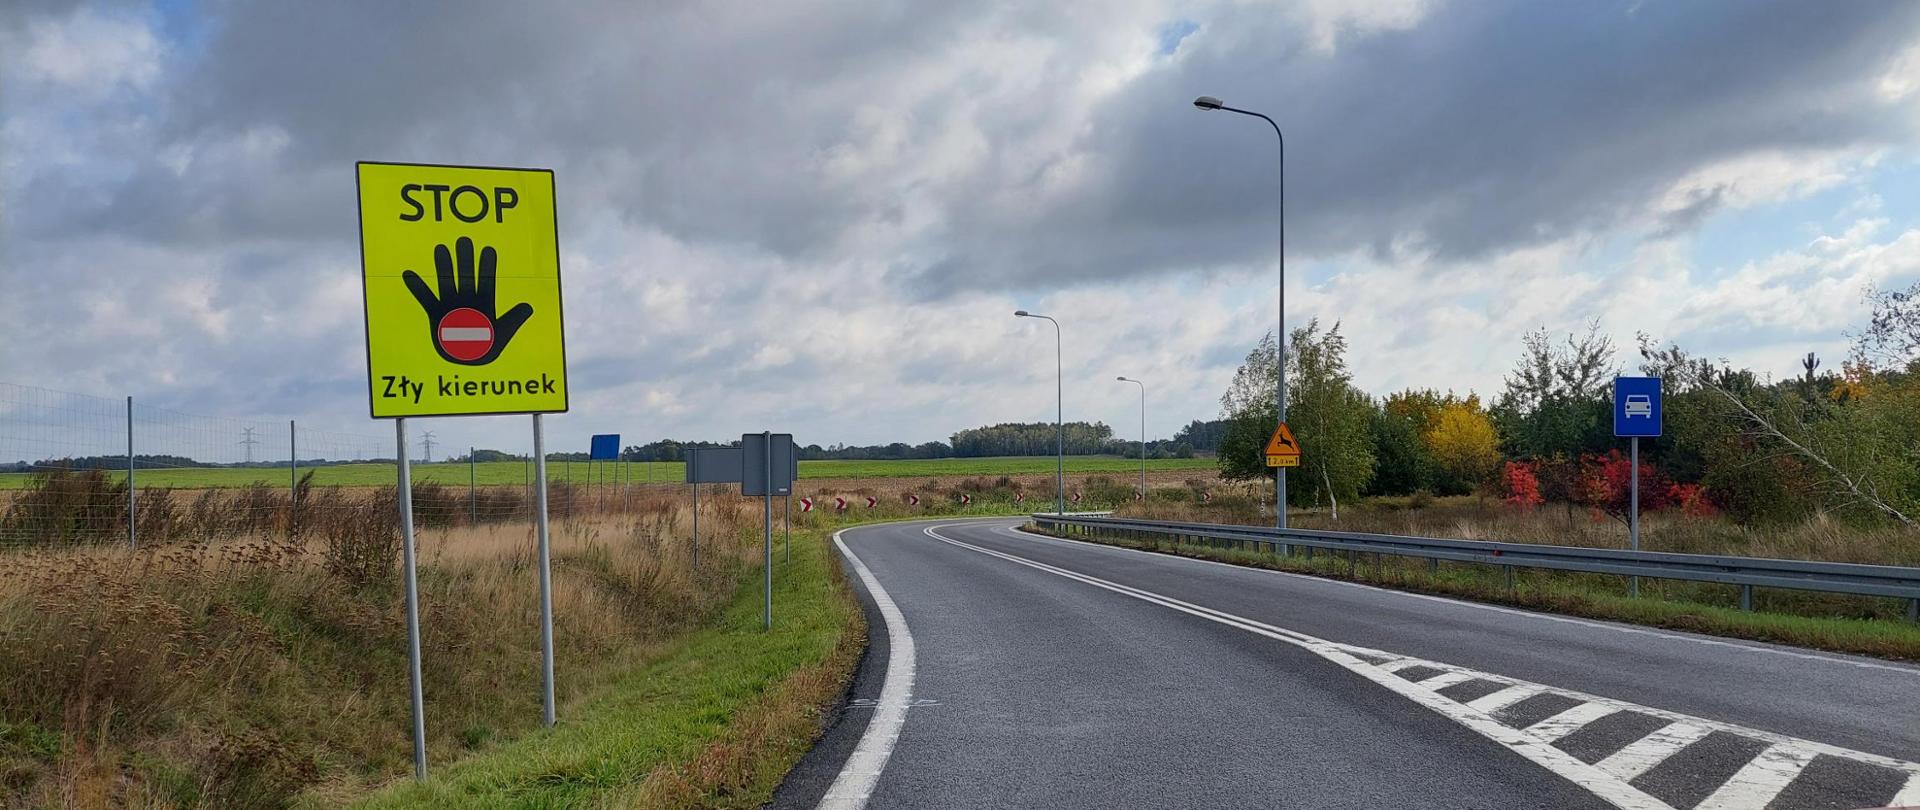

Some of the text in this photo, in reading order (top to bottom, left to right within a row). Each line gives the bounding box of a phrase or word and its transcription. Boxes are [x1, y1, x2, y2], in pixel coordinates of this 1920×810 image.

[400, 183, 519, 223] STOP
[382, 373, 556, 404] Zły kierunek
